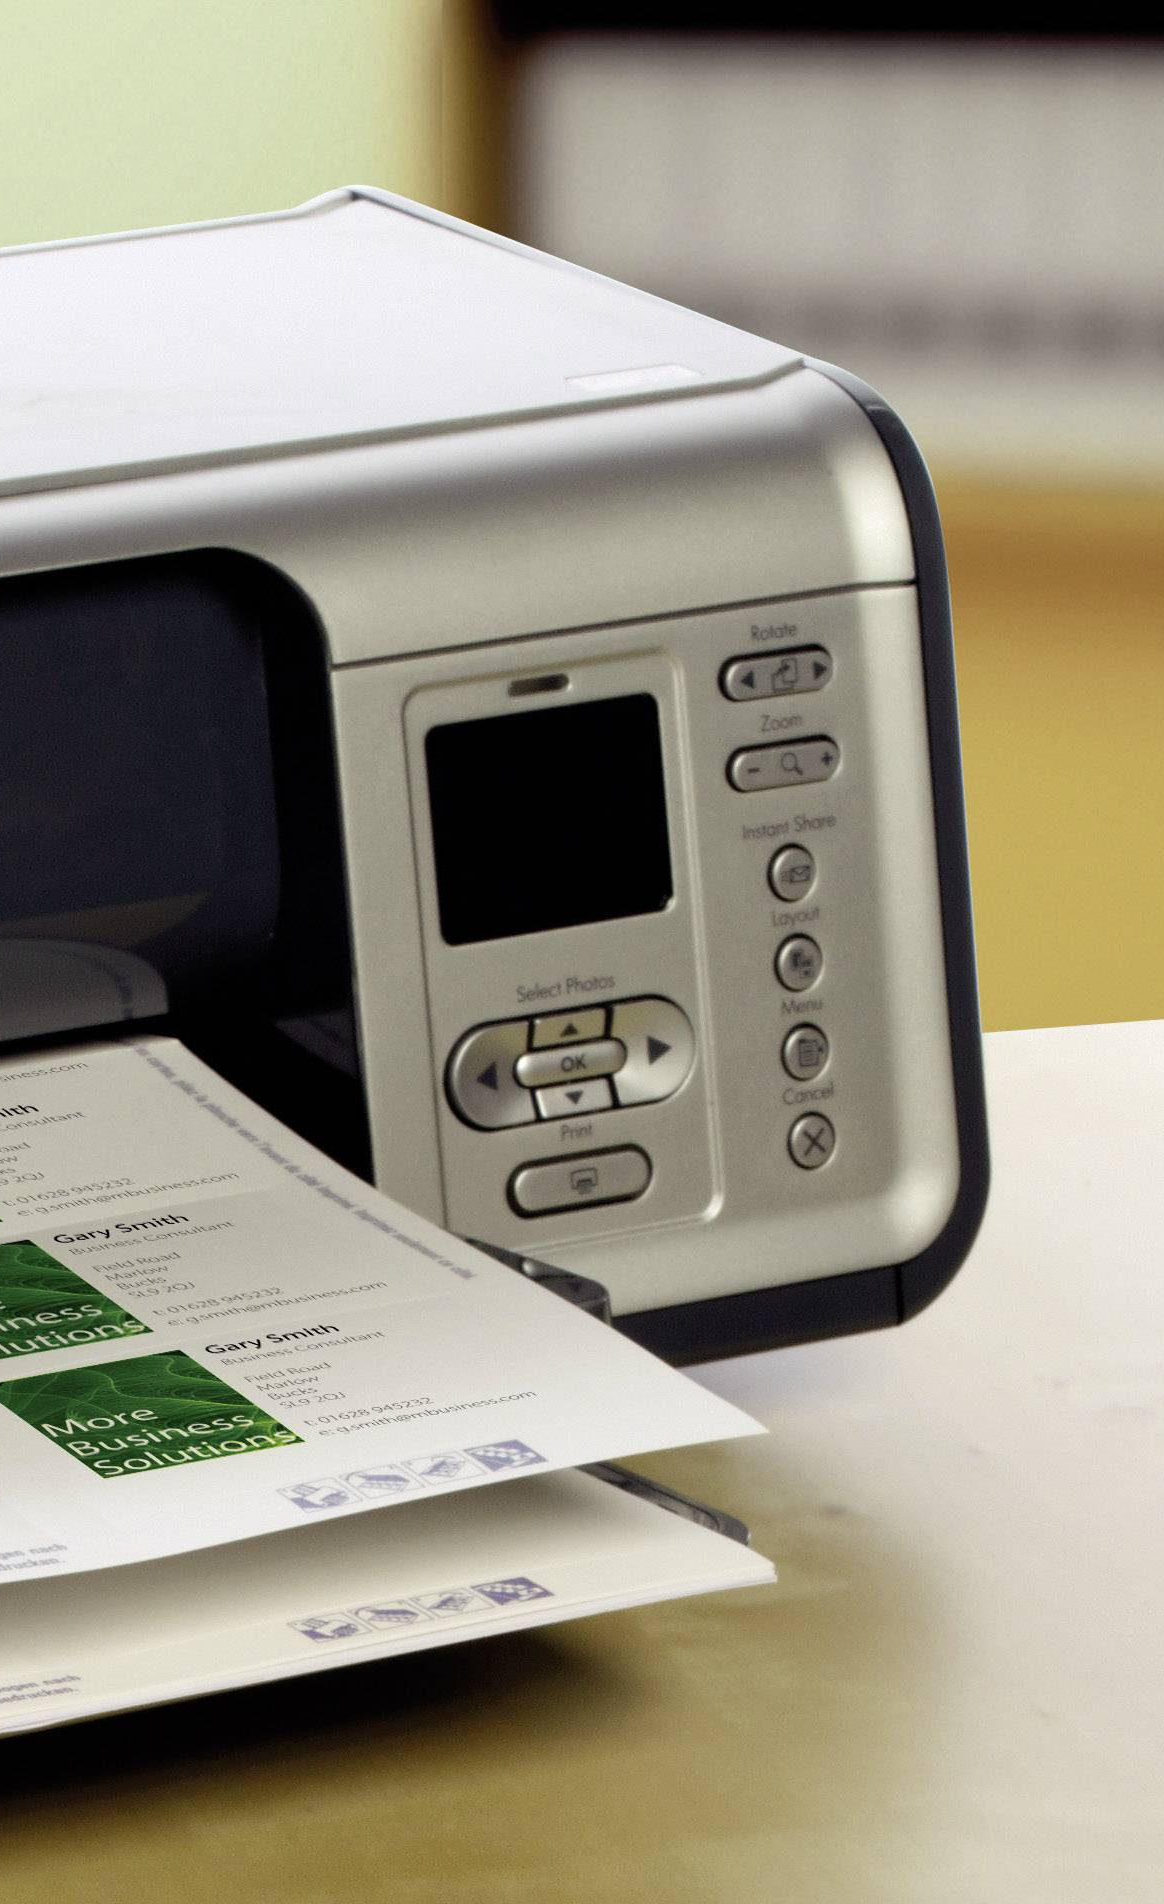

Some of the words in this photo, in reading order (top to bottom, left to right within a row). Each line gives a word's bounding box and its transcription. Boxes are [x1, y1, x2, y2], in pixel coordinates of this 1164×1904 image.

[750, 621, 797, 641] Rotate
[760, 712, 803, 731] Zoom
[741, 817, 793, 841] Instant
[793, 813, 837, 834] Share
[771, 907, 821, 929] Layout
[516, 982, 559, 1004] Select
[563, 975, 615, 997] Photos
[781, 997, 824, 1015] Menu
[560, 1055, 588, 1073] OK
[782, 1084, 834, 1105] Cancel
[560, 1124, 593, 1141] Print
[54, 1229, 110, 1243] Gary
[115, 1215, 189, 1233] Smith
[68, 1239, 142, 1255] Business
[143, 1222, 234, 1241] Consultant
[92, 1260, 135, 1272] Field
[136, 1252, 181, 1265] Road
[105, 1266, 168, 1281] Marlow
[116, 1277, 166, 1290] Bucks
[205, 1339, 261, 1353] Gary
[266, 1325, 339, 1343] Smith
[220, 1349, 293, 1365] Business
[294, 1332, 385, 1351] Consultant
[244, 1371, 286, 1382] Field
[286, 1362, 331, 1374] Road
[256, 1376, 318, 1391] Marlow
[267, 1388, 317, 1400] Bucks
[42, 1410, 158, 1437] More
[67, 1416, 254, 1456] Business
[94, 1431, 296, 1474] Solutions
